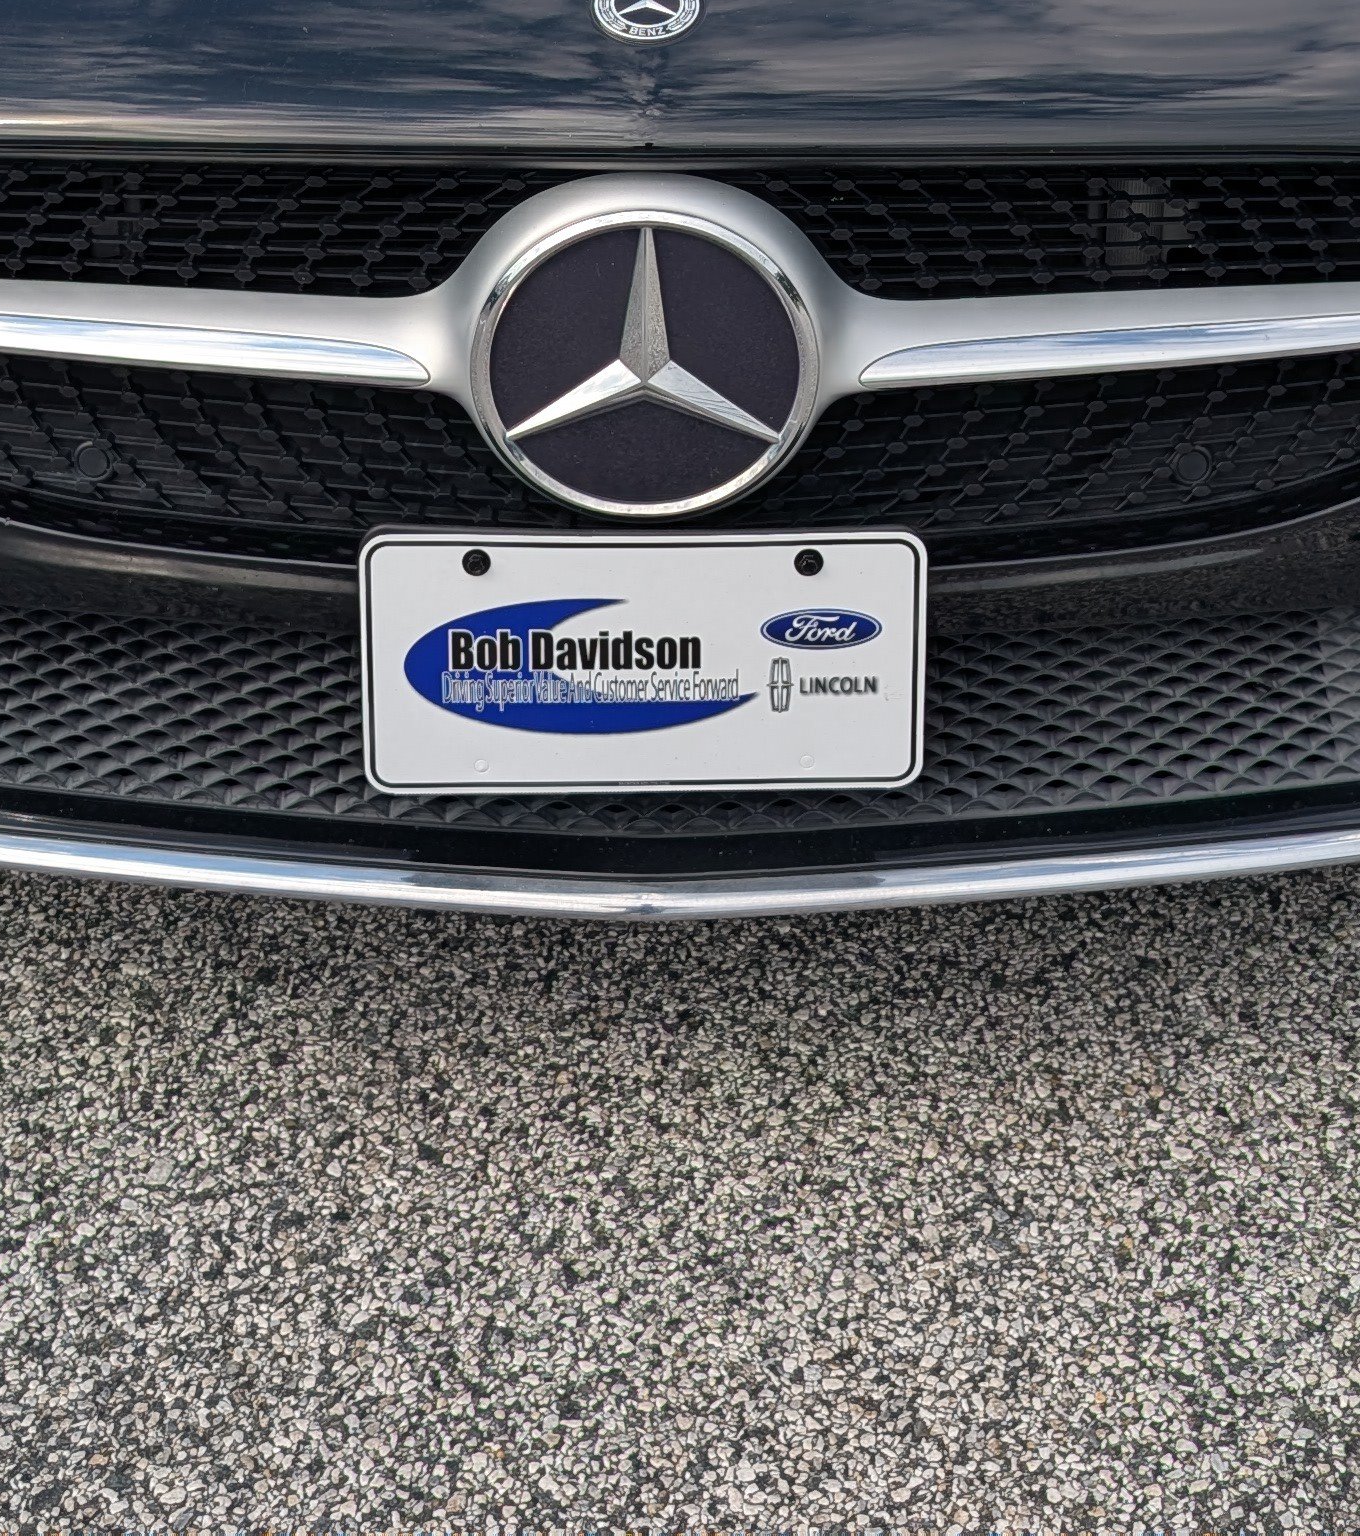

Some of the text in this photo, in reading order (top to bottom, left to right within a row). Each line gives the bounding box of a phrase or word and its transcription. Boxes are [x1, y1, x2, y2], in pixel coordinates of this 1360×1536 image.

[628, 26, 666, 37] BENZ
[784, 614, 858, 642] Ford
[450, 630, 702, 671] Bob Davidson
[442, 668, 740, 712] Driving Superior Value And Customer Service Forward
[799, 675, 878, 695] LINCOLN
